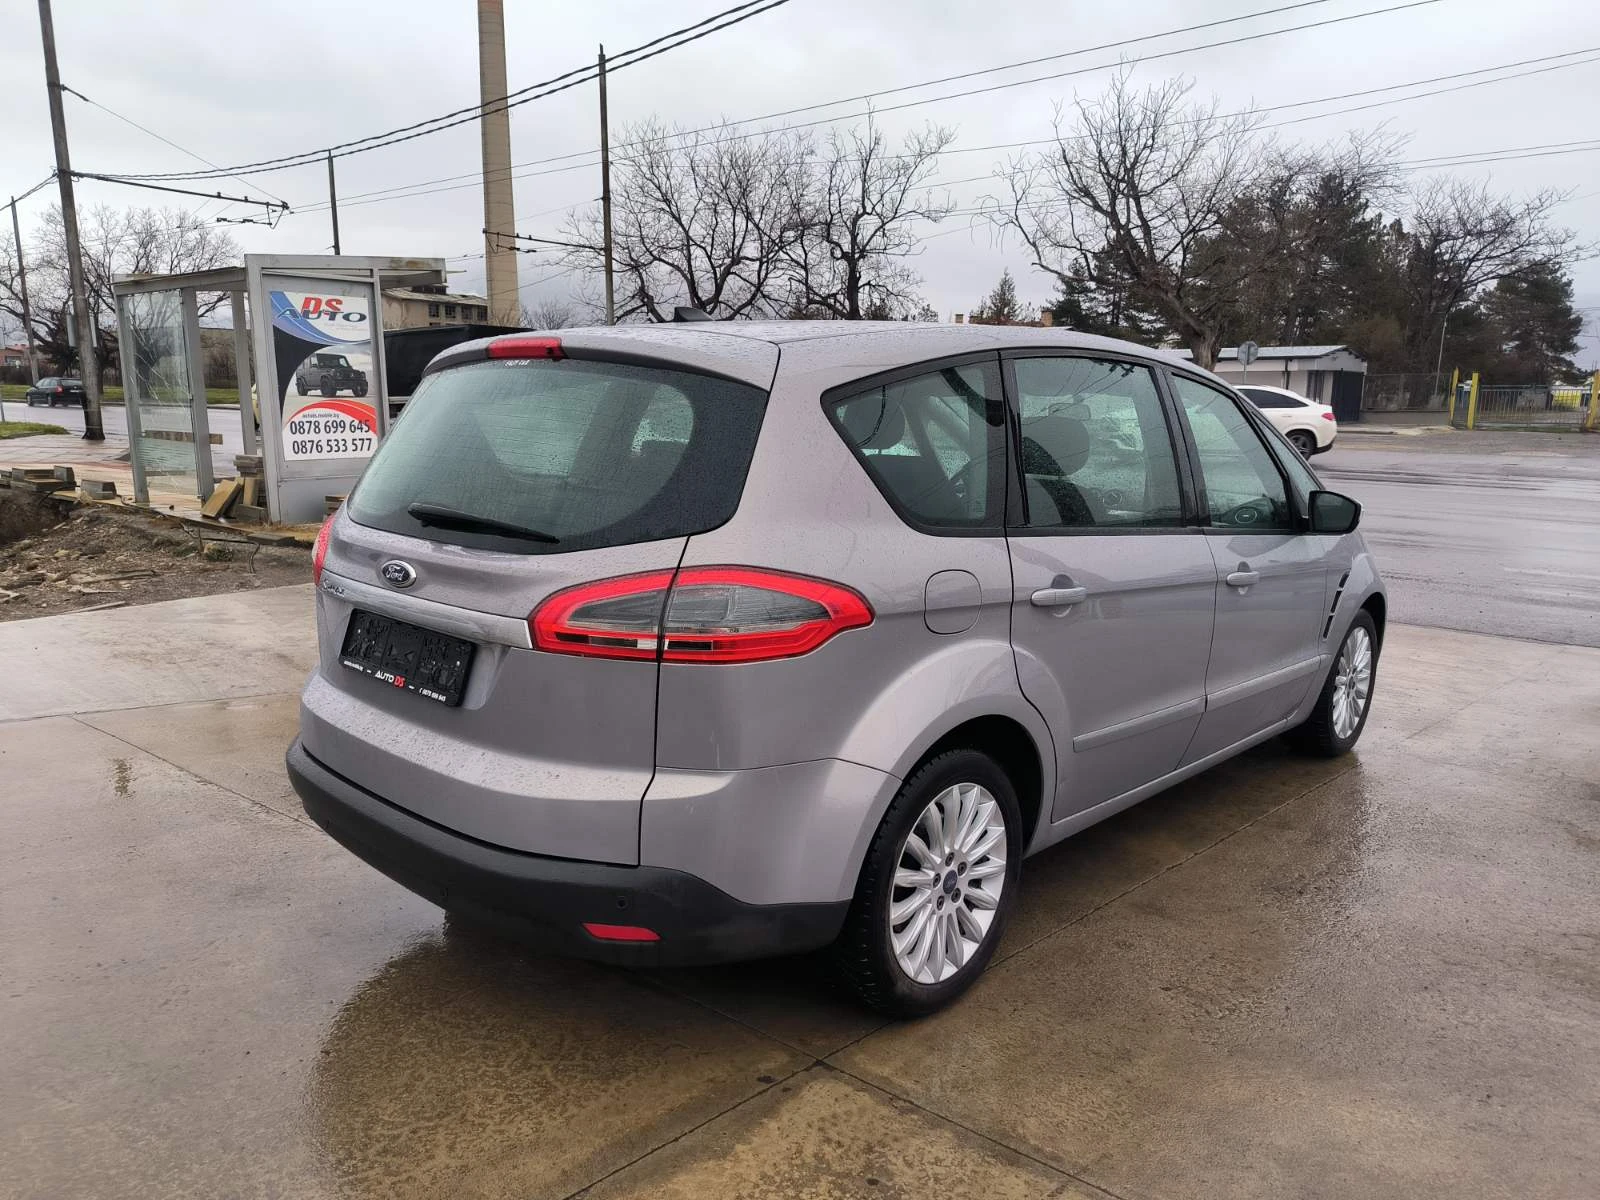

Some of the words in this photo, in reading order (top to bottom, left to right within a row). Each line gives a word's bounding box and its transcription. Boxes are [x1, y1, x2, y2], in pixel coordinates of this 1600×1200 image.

[301, 297, 343, 315] DS
[277, 308, 367, 323] AUTO
[290, 420, 321, 435] 0878
[324, 420, 346, 434] 699
[349, 419, 370, 433] 645
[292, 440, 323, 454] 0876
[326, 439, 348, 453] 533
[351, 438, 372, 452] 577
[386, 565, 405, 581] Ford
[375, 670, 394, 683] AUTO
[394, 675, 406, 687] DS
